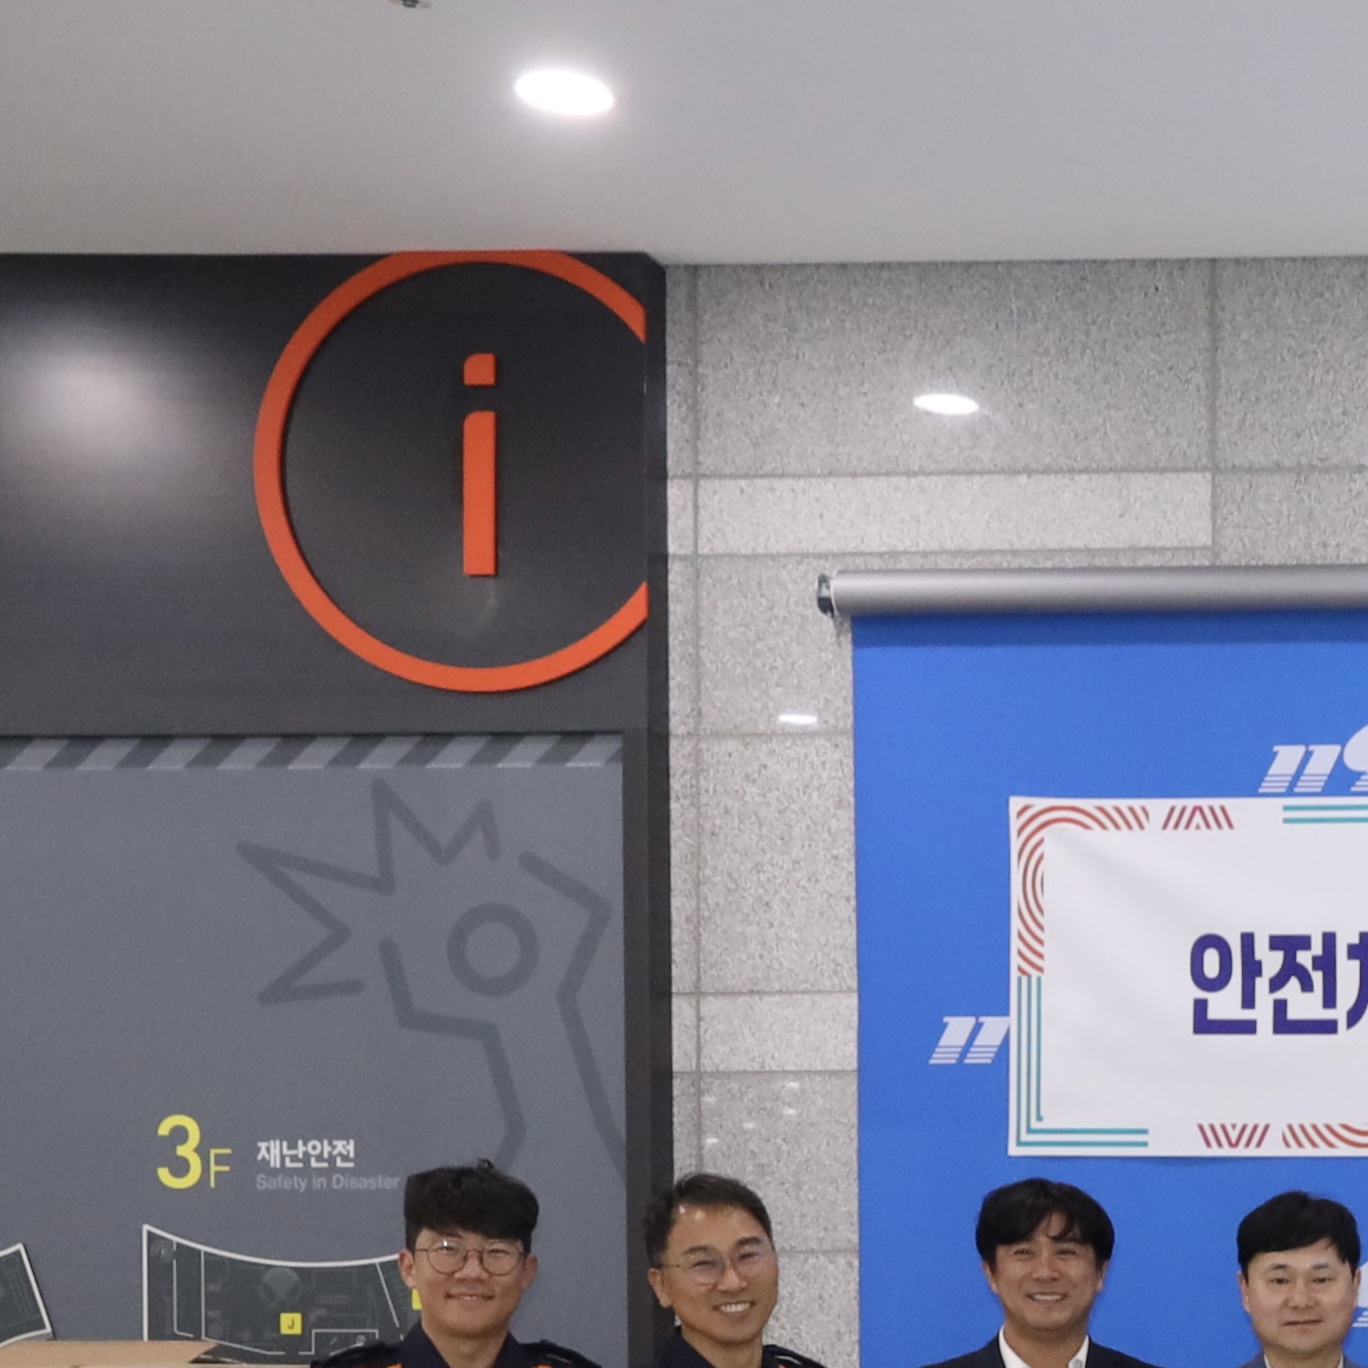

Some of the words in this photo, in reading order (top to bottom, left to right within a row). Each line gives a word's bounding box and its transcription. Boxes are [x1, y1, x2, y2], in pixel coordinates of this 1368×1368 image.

[463, 353, 497, 576] i
[928, 1016, 1010, 1065] 11
[256, 1138, 355, 1169] 재난안전
[256, 1174, 307, 1192] Safety
[313, 1174, 327, 1190] in
[332, 1173, 400, 1190] Disaster
[287, 1318, 295, 1330] J
